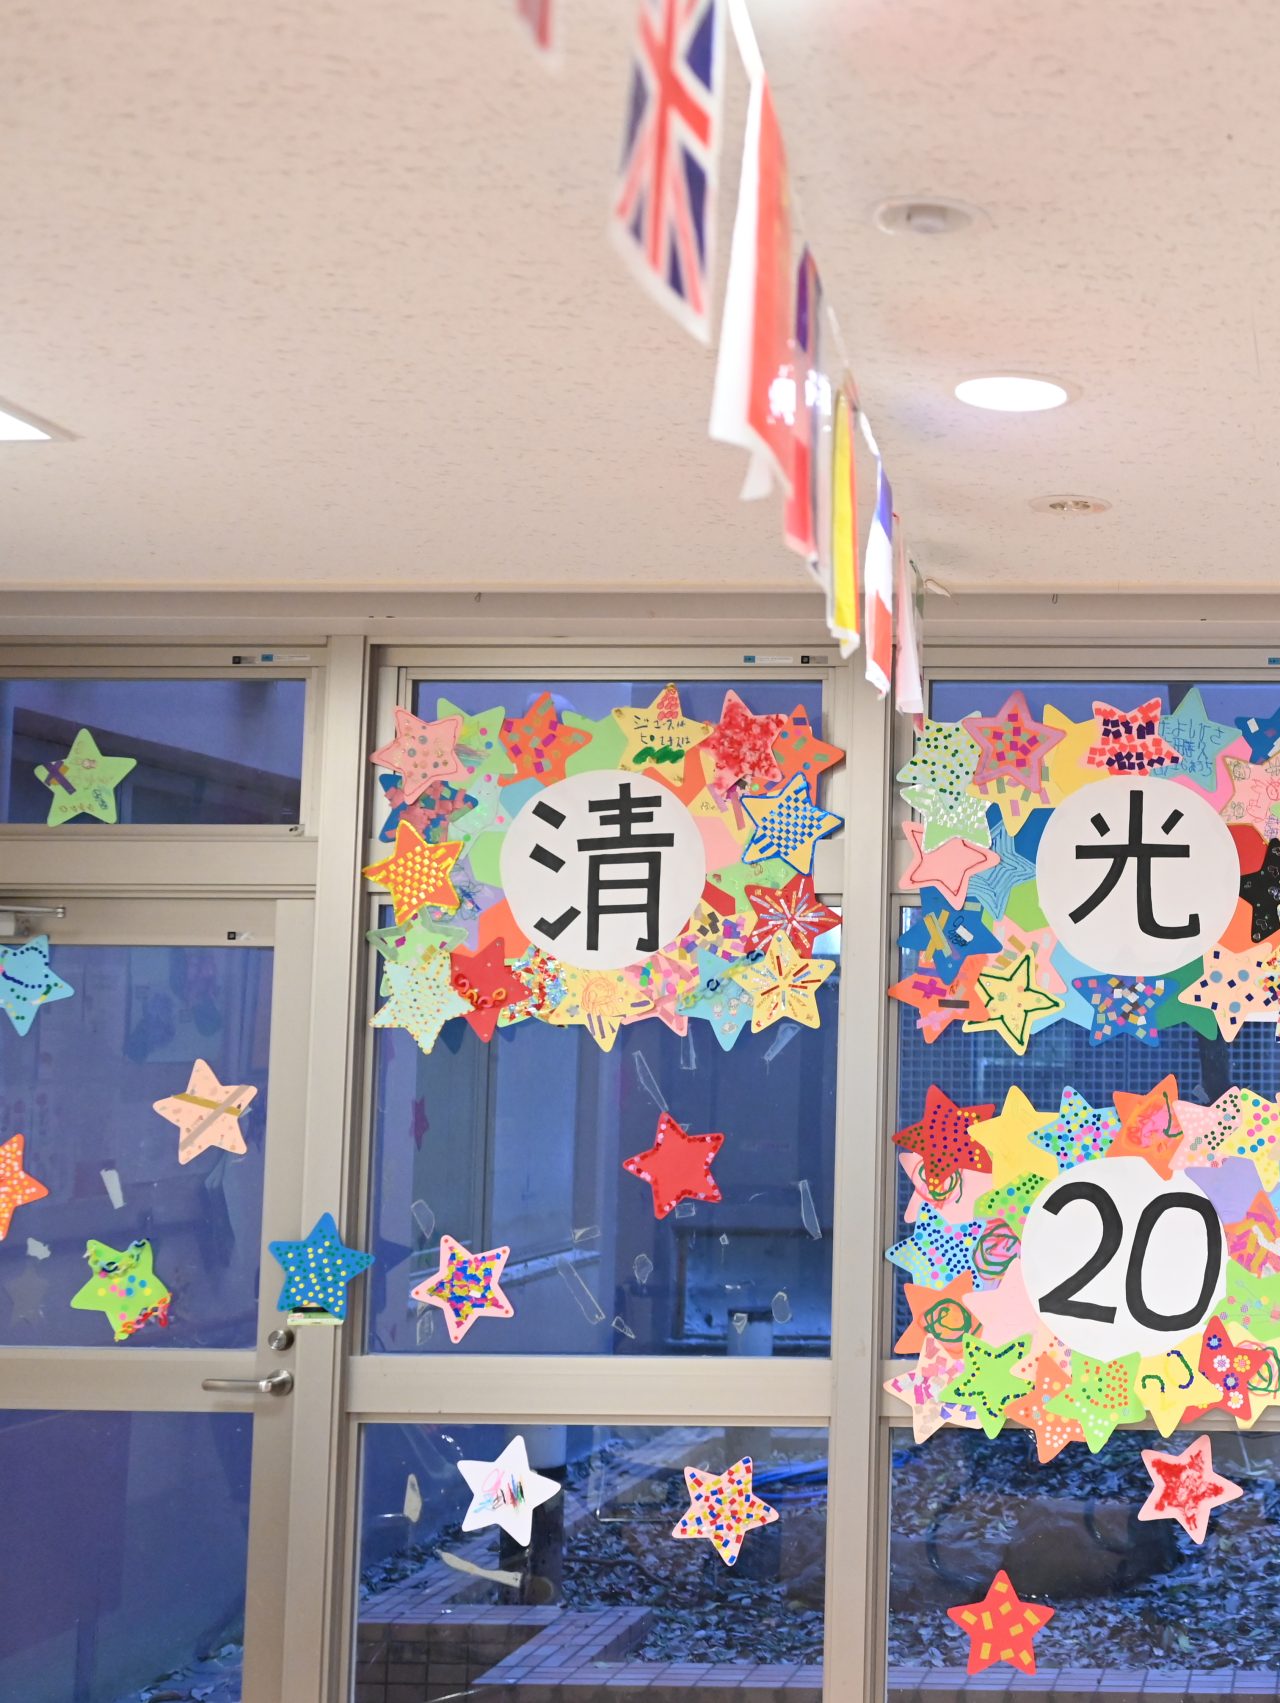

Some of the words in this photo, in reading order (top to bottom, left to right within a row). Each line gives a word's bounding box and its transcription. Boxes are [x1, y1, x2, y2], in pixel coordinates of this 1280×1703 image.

[530, 782, 675, 953] 清
[1068, 789, 1201, 940] 光
[1038, 1181, 1222, 1332] 20
